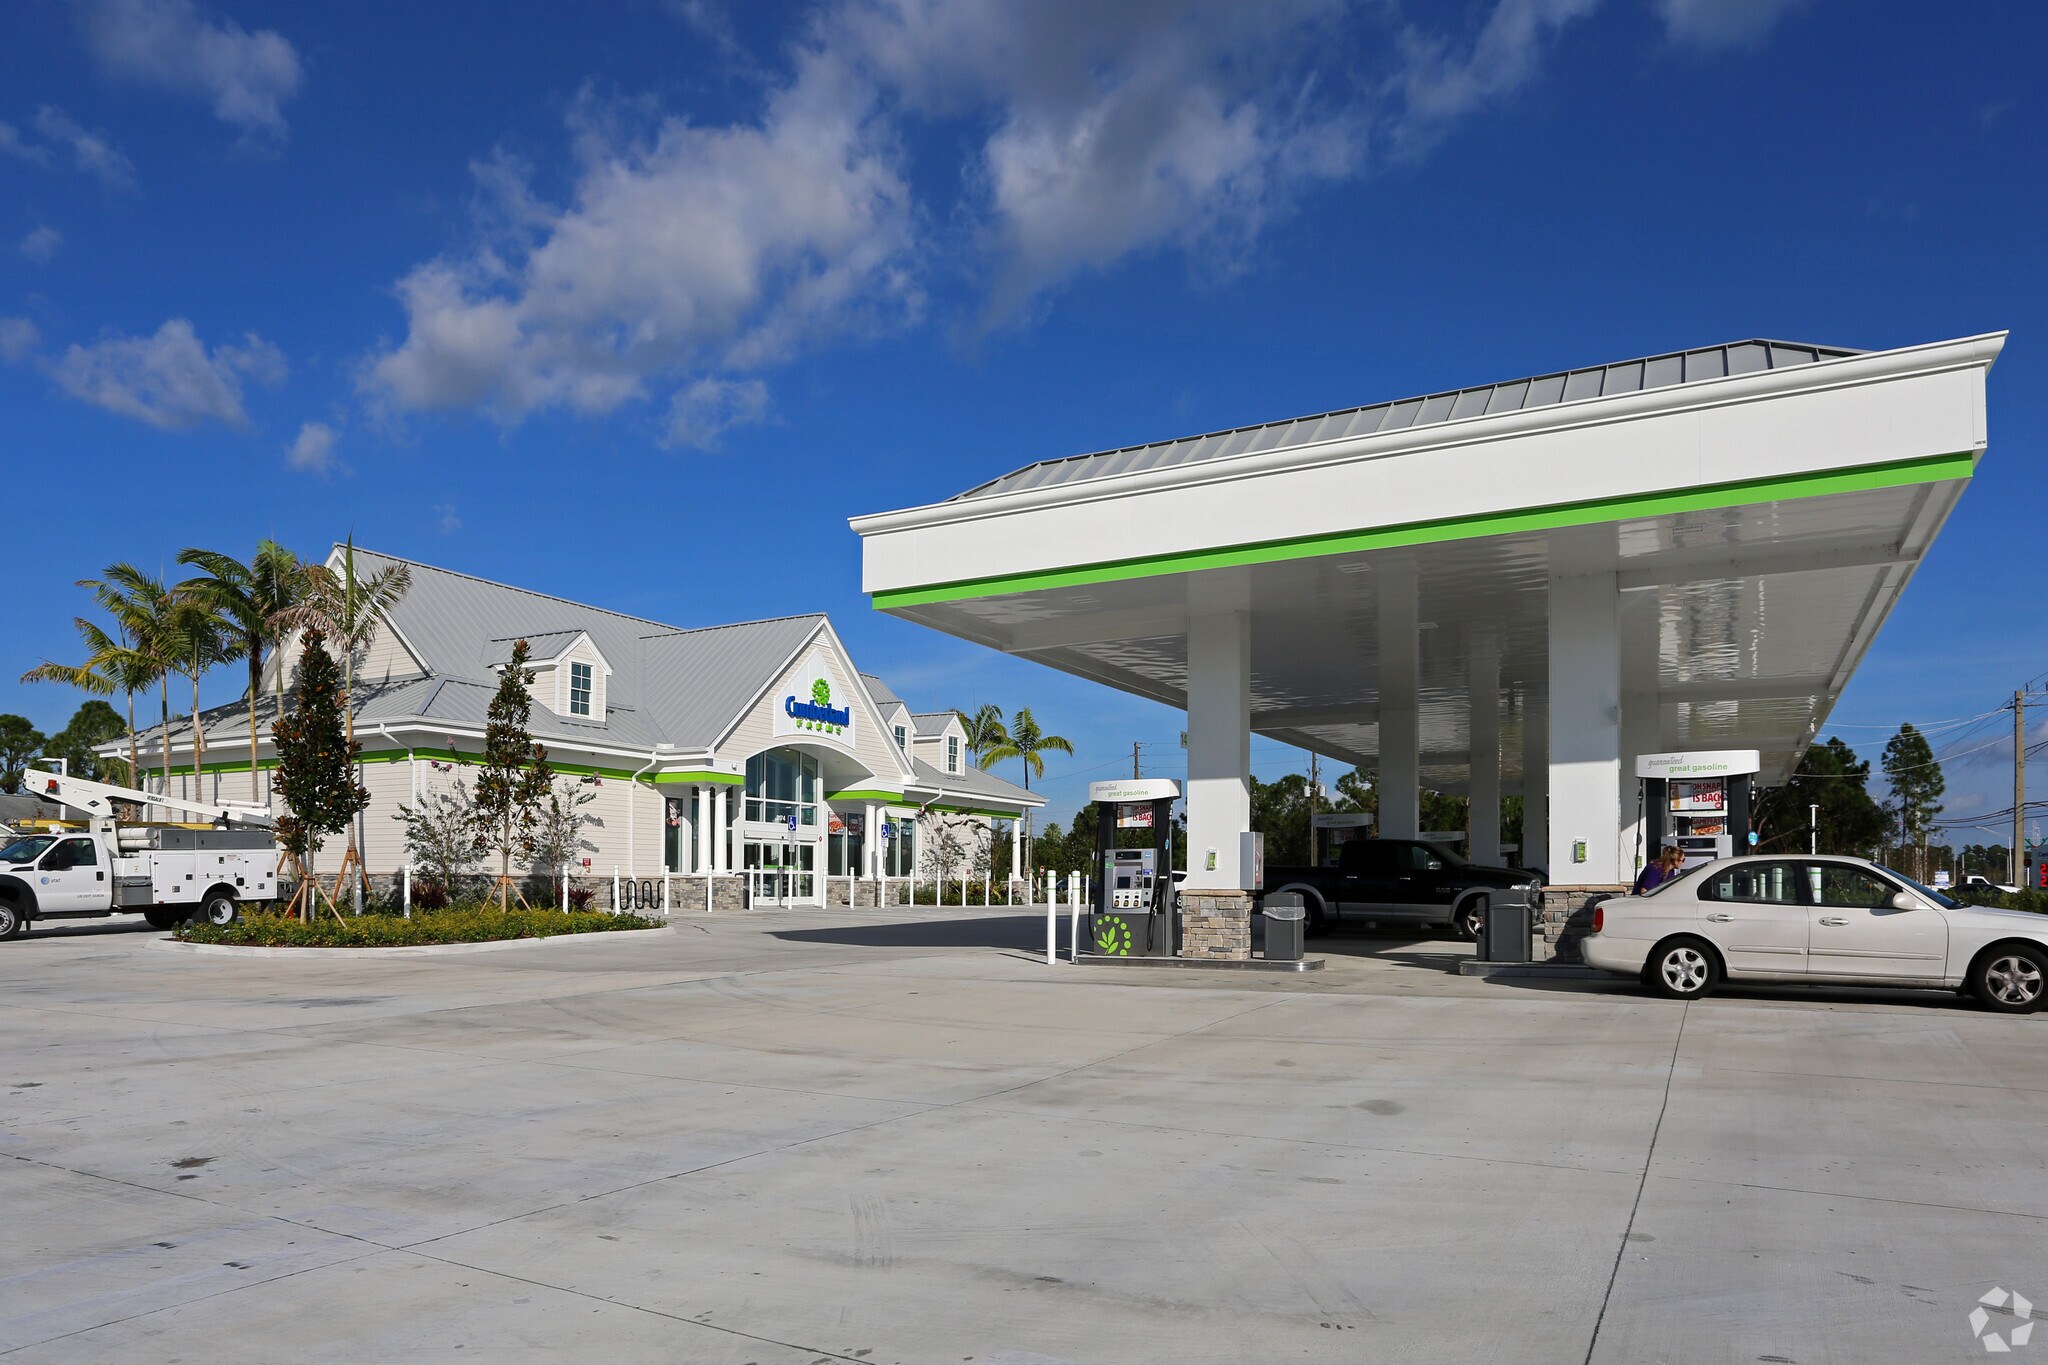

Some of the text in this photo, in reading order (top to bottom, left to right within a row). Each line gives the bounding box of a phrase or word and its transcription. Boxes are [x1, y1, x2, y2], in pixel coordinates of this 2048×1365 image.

[785, 695, 850, 728] Cumberland
[796, 719, 842, 736] FARMS
[1648, 755, 1684, 769] guaranteed
[1669, 763, 1728, 773] great gasoline
[1123, 789, 1149, 797] gasoline
[1692, 794, 1700, 803] IS
